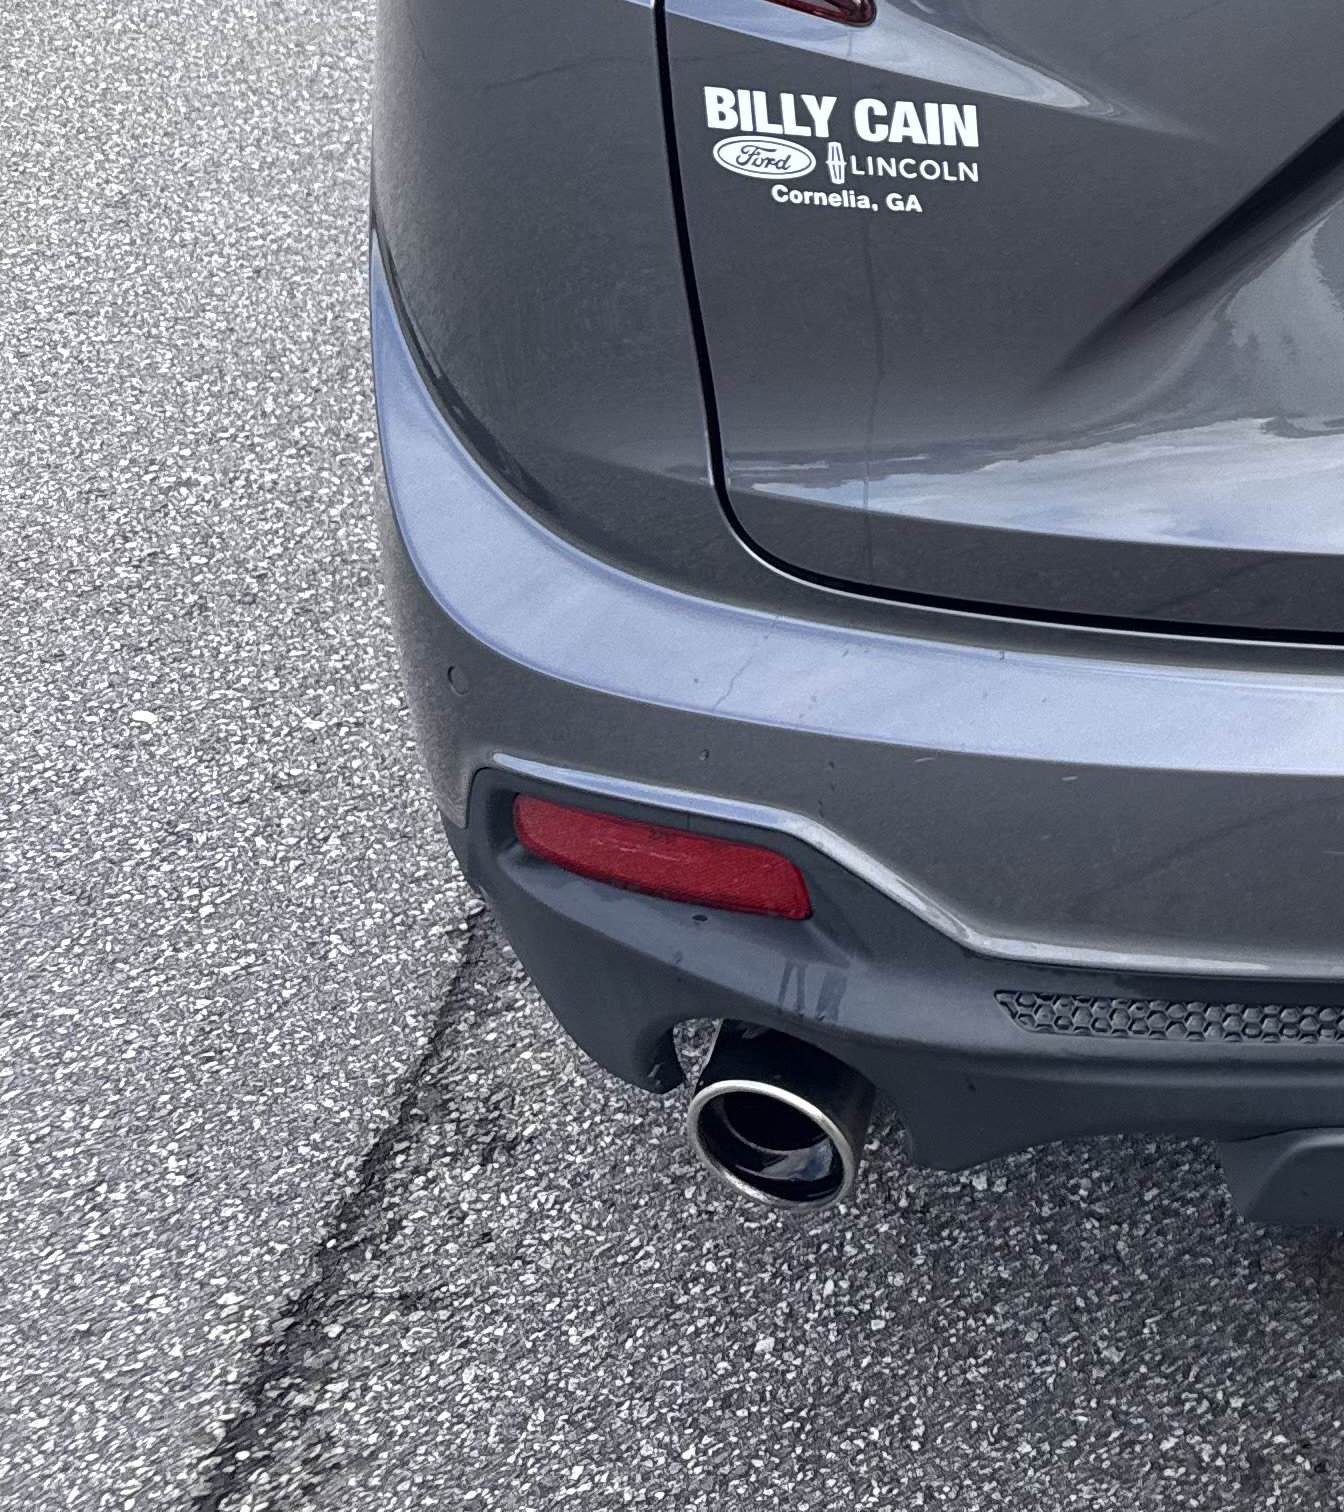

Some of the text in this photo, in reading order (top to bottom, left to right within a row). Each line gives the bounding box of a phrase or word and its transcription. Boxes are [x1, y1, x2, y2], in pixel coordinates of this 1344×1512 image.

[704, 86, 980, 147] BILLY CAIN
[736, 144, 792, 170] Ford
[850, 154, 979, 182] LINCOLN
[771, 184, 923, 213] Cornelia, GA
